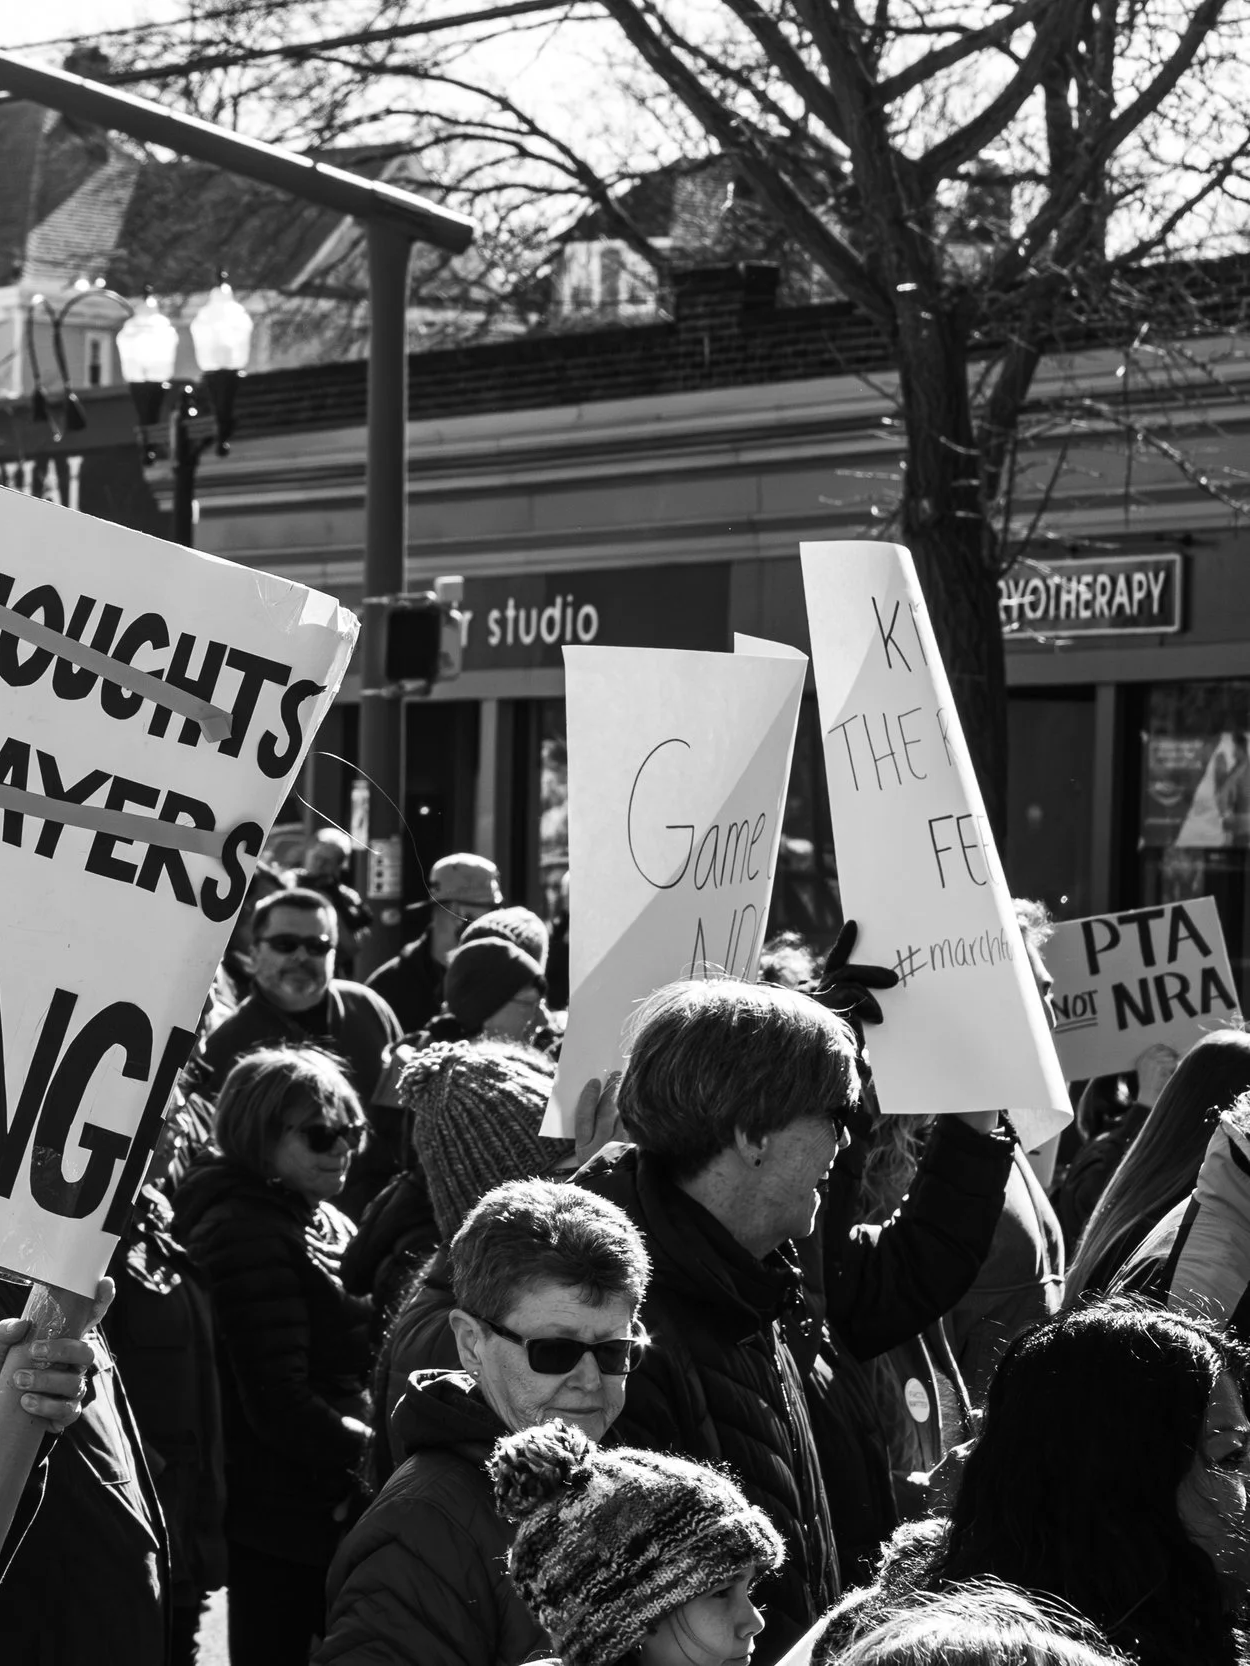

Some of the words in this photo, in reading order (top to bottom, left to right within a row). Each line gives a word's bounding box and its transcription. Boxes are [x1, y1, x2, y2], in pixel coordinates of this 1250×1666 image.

[488, 593, 599, 647] studio
[628, 738, 766, 890] Game
[1081, 905, 1212, 976] PTA
[1051, 990, 1098, 1020] NOT
[1112, 967, 1236, 1032] NRA
